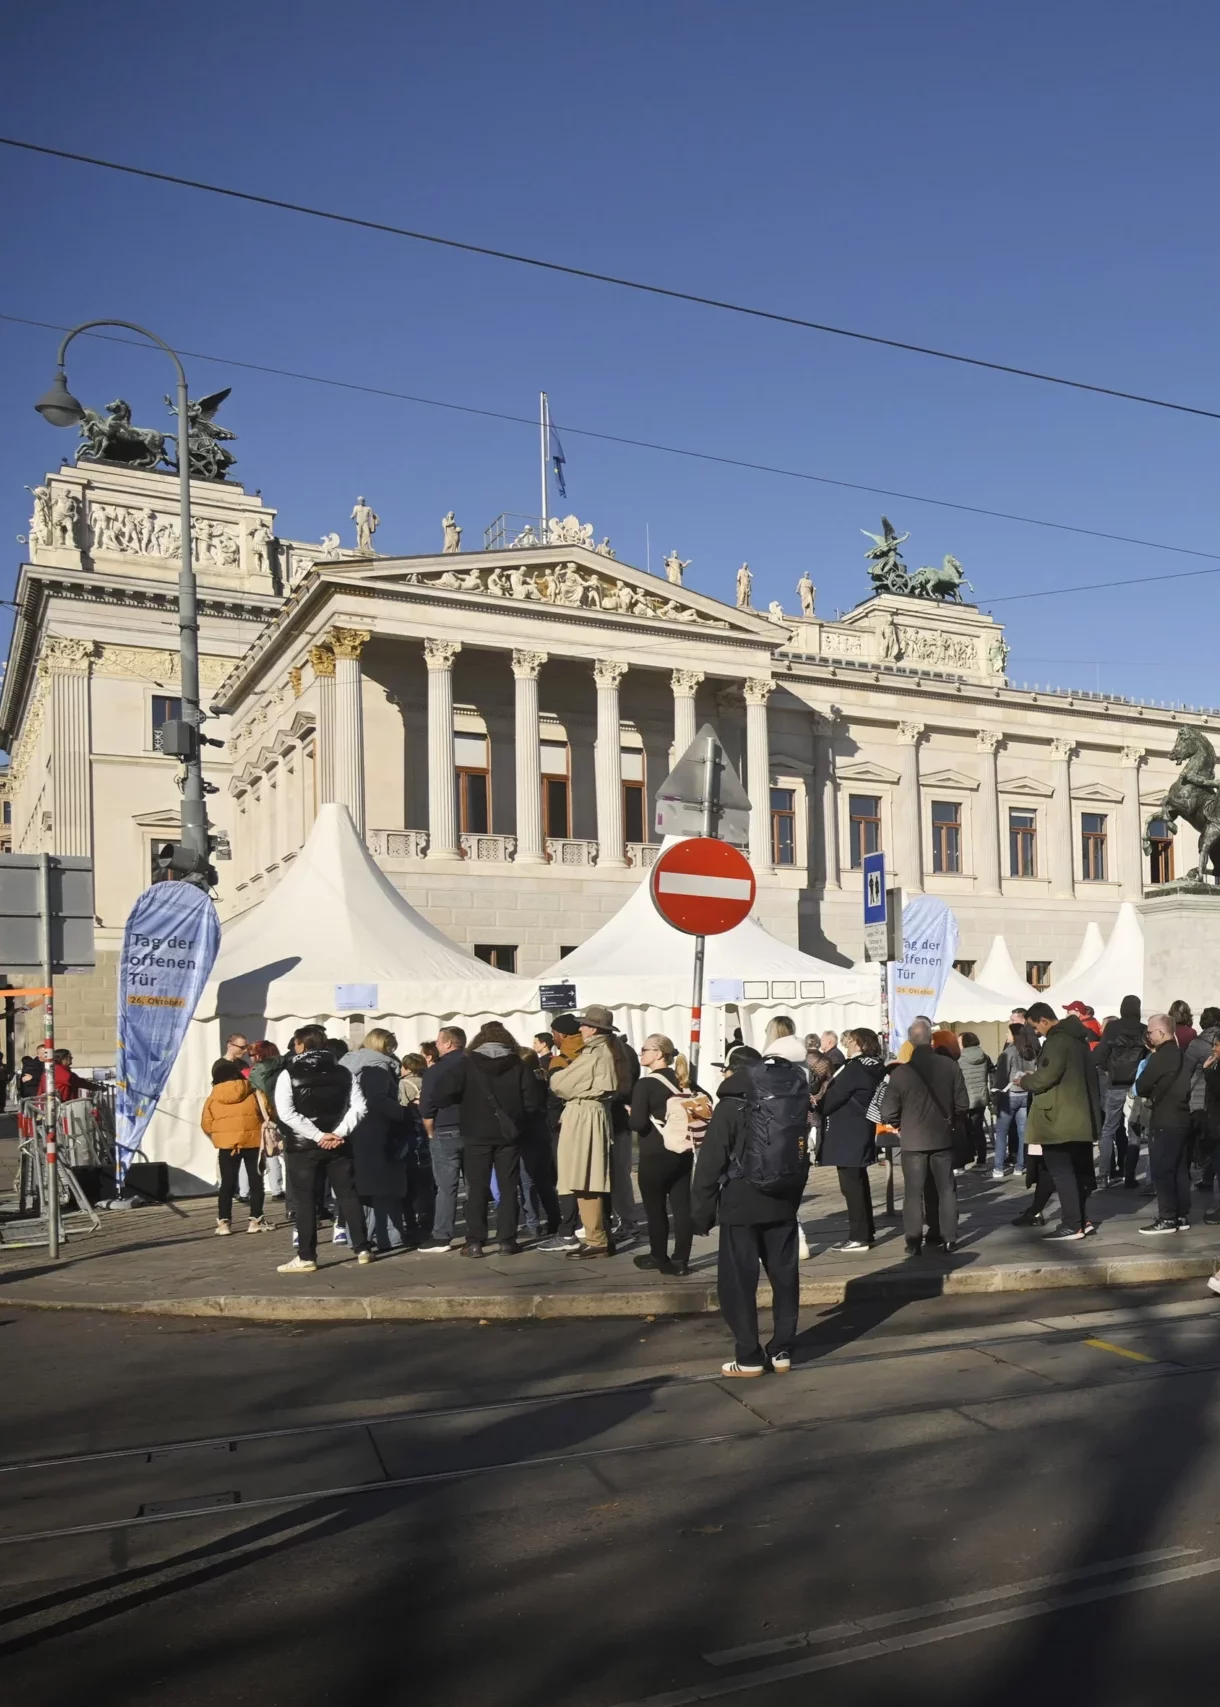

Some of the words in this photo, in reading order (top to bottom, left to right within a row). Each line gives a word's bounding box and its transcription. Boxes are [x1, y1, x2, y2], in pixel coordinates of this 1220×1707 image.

[131, 933, 162, 950] Tag
[168, 935, 194, 951] der
[902, 937, 918, 951] ag
[922, 938, 941, 951] der
[129, 953, 196, 970] offenen
[128, 972, 157, 987] Tür
[897, 968, 916, 980] Tür
[147, 997, 183, 1007] Oktober
